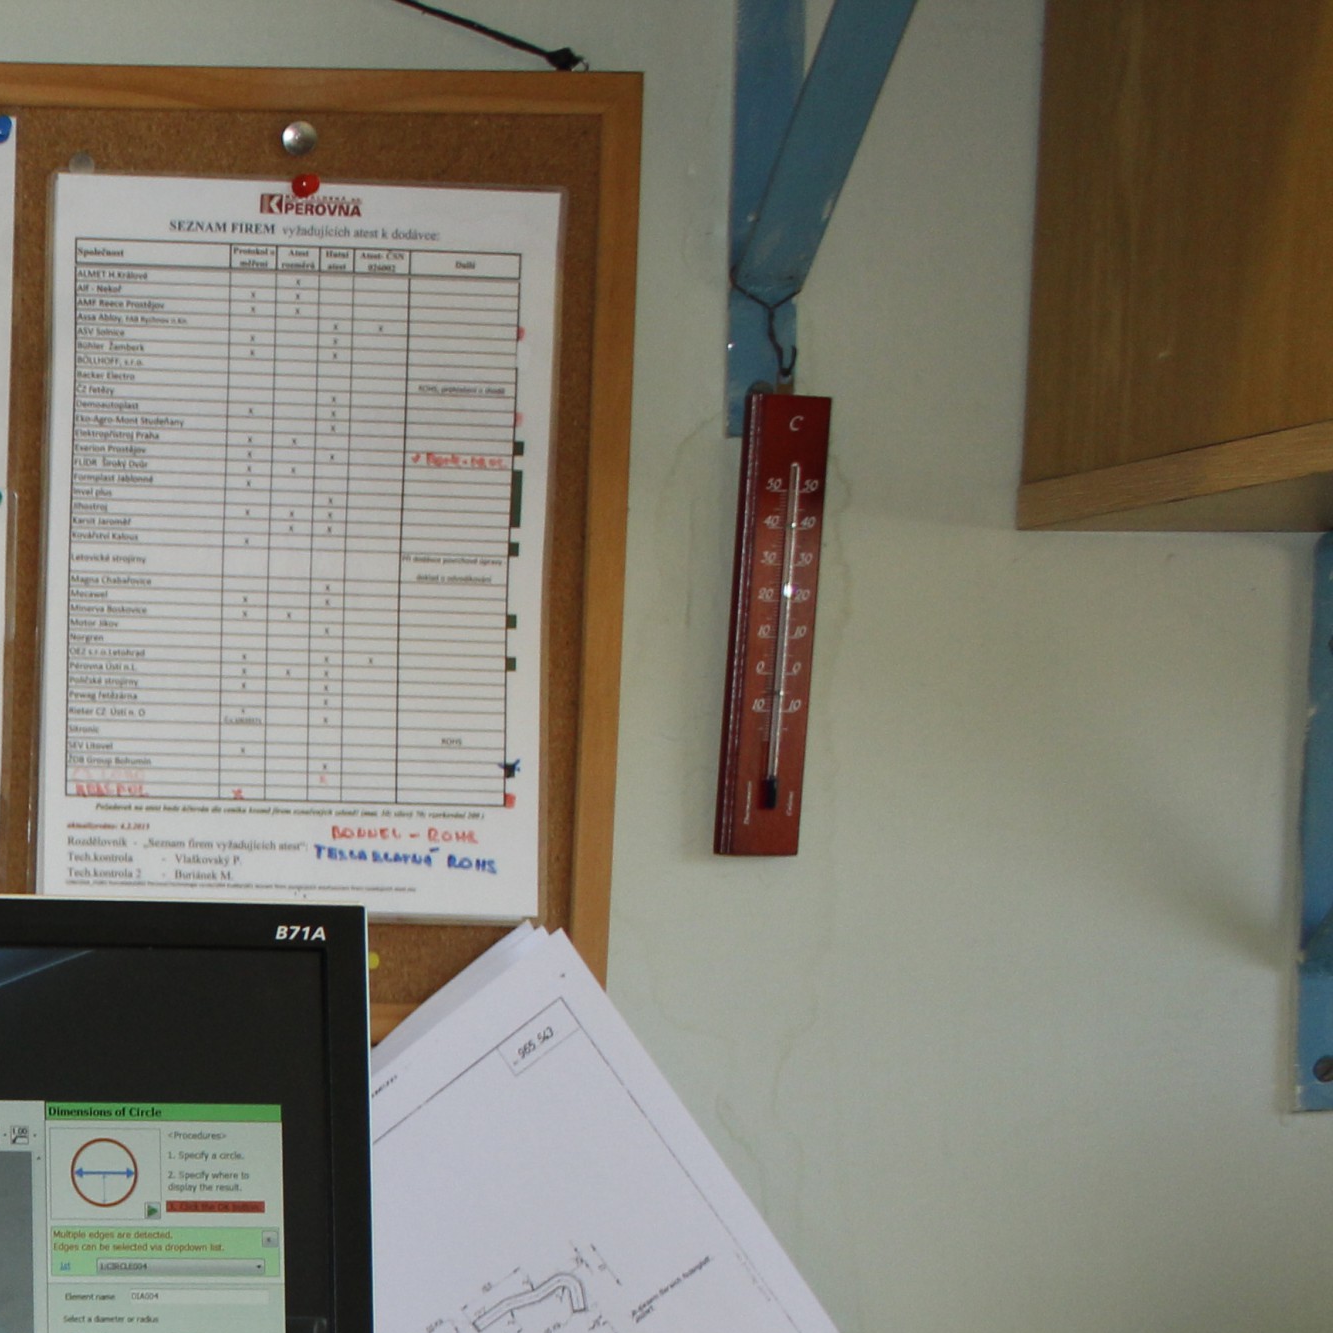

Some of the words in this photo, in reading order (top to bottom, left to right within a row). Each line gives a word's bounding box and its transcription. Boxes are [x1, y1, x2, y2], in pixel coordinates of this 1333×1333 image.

[284, 202, 363, 218] PEROVNA
[169, 219, 227, 234] SEZNAM
[231, 221, 276, 236] FIREM
[282, 224, 351, 241] vyžadujících
[353, 227, 379, 240] atest
[380, 227, 389, 240] k
[391, 228, 442, 242] dodávce:
[788, 414, 805, 432] C
[763, 514, 781, 527] 40
[800, 515, 817, 528] 40
[757, 624, 771, 637] 10
[793, 625, 807, 638] 10
[66, 835, 128, 848] Rozdělovník
[188, 837, 214, 850] firem
[216, 838, 277, 853] vyžadujících
[67, 851, 133, 864] Tech.kontrola
[67, 867, 134, 880] Tech.kontrola
[275, 924, 327, 942] B71A
[48, 1106, 113, 1117] Dimensions
[114, 1106, 127, 1118] of
[129, 1106, 163, 1118] Circle
[167, 1130, 227, 1141] <Procedures>
[178, 1151, 210, 1162] Specify
[219, 1151, 245, 1161] circle.
[178, 1170, 210, 1182] Specify
[211, 1170, 240, 1181] where
[240, 1171, 250, 1181] to
[167, 1182, 198, 1194] display
[199, 1182, 214, 1192] the
[215, 1182, 243, 1193] result.
[53, 1230, 86, 1241] Multiple
[88, 1230, 115, 1242] edges
[117, 1232, 131, 1241] are
[133, 1230, 173, 1241] detected.
[53, 1242, 80, 1254] Edges
[81, 1243, 97, 1252] can
[99, 1242, 111, 1252] be
[112, 1242, 149, 1253] selected
[150, 1243, 163, 1252] via
[165, 1242, 208, 1254] dropdown
[64, 1292, 93, 1301] Element
[63, 1315, 86, 1324] Select
[95, 1315, 125, 1324] diameter
[136, 1315, 159, 1324] radius
